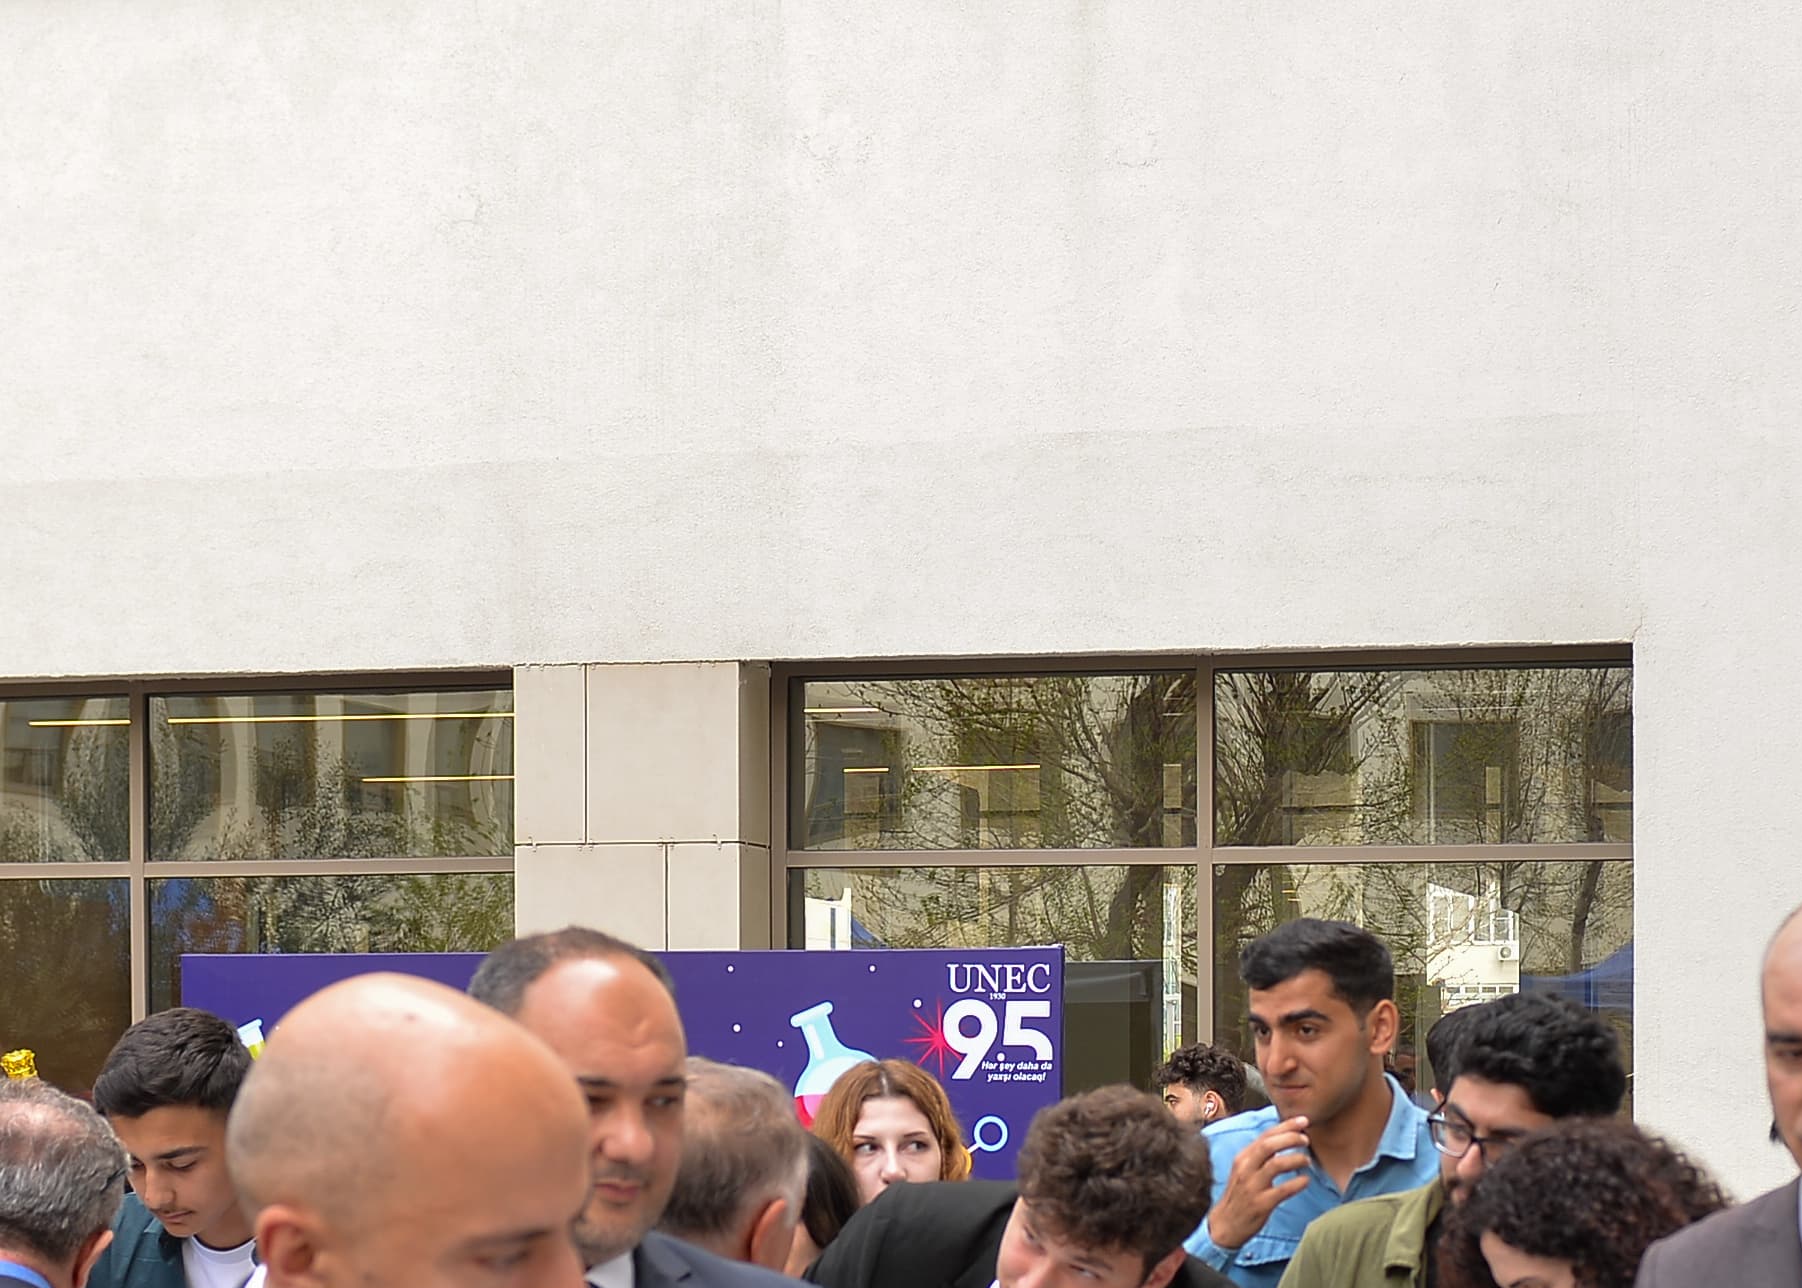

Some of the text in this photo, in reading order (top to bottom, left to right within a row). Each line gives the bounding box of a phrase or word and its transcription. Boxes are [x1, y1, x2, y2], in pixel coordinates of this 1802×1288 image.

[946, 963, 1051, 993] UNEC
[942, 998, 1054, 1080] 95
[1016, 1061, 1039, 1071] daha
[1040, 1061, 1053, 1071] da
[1012, 1071, 1047, 1083] olacaq!
